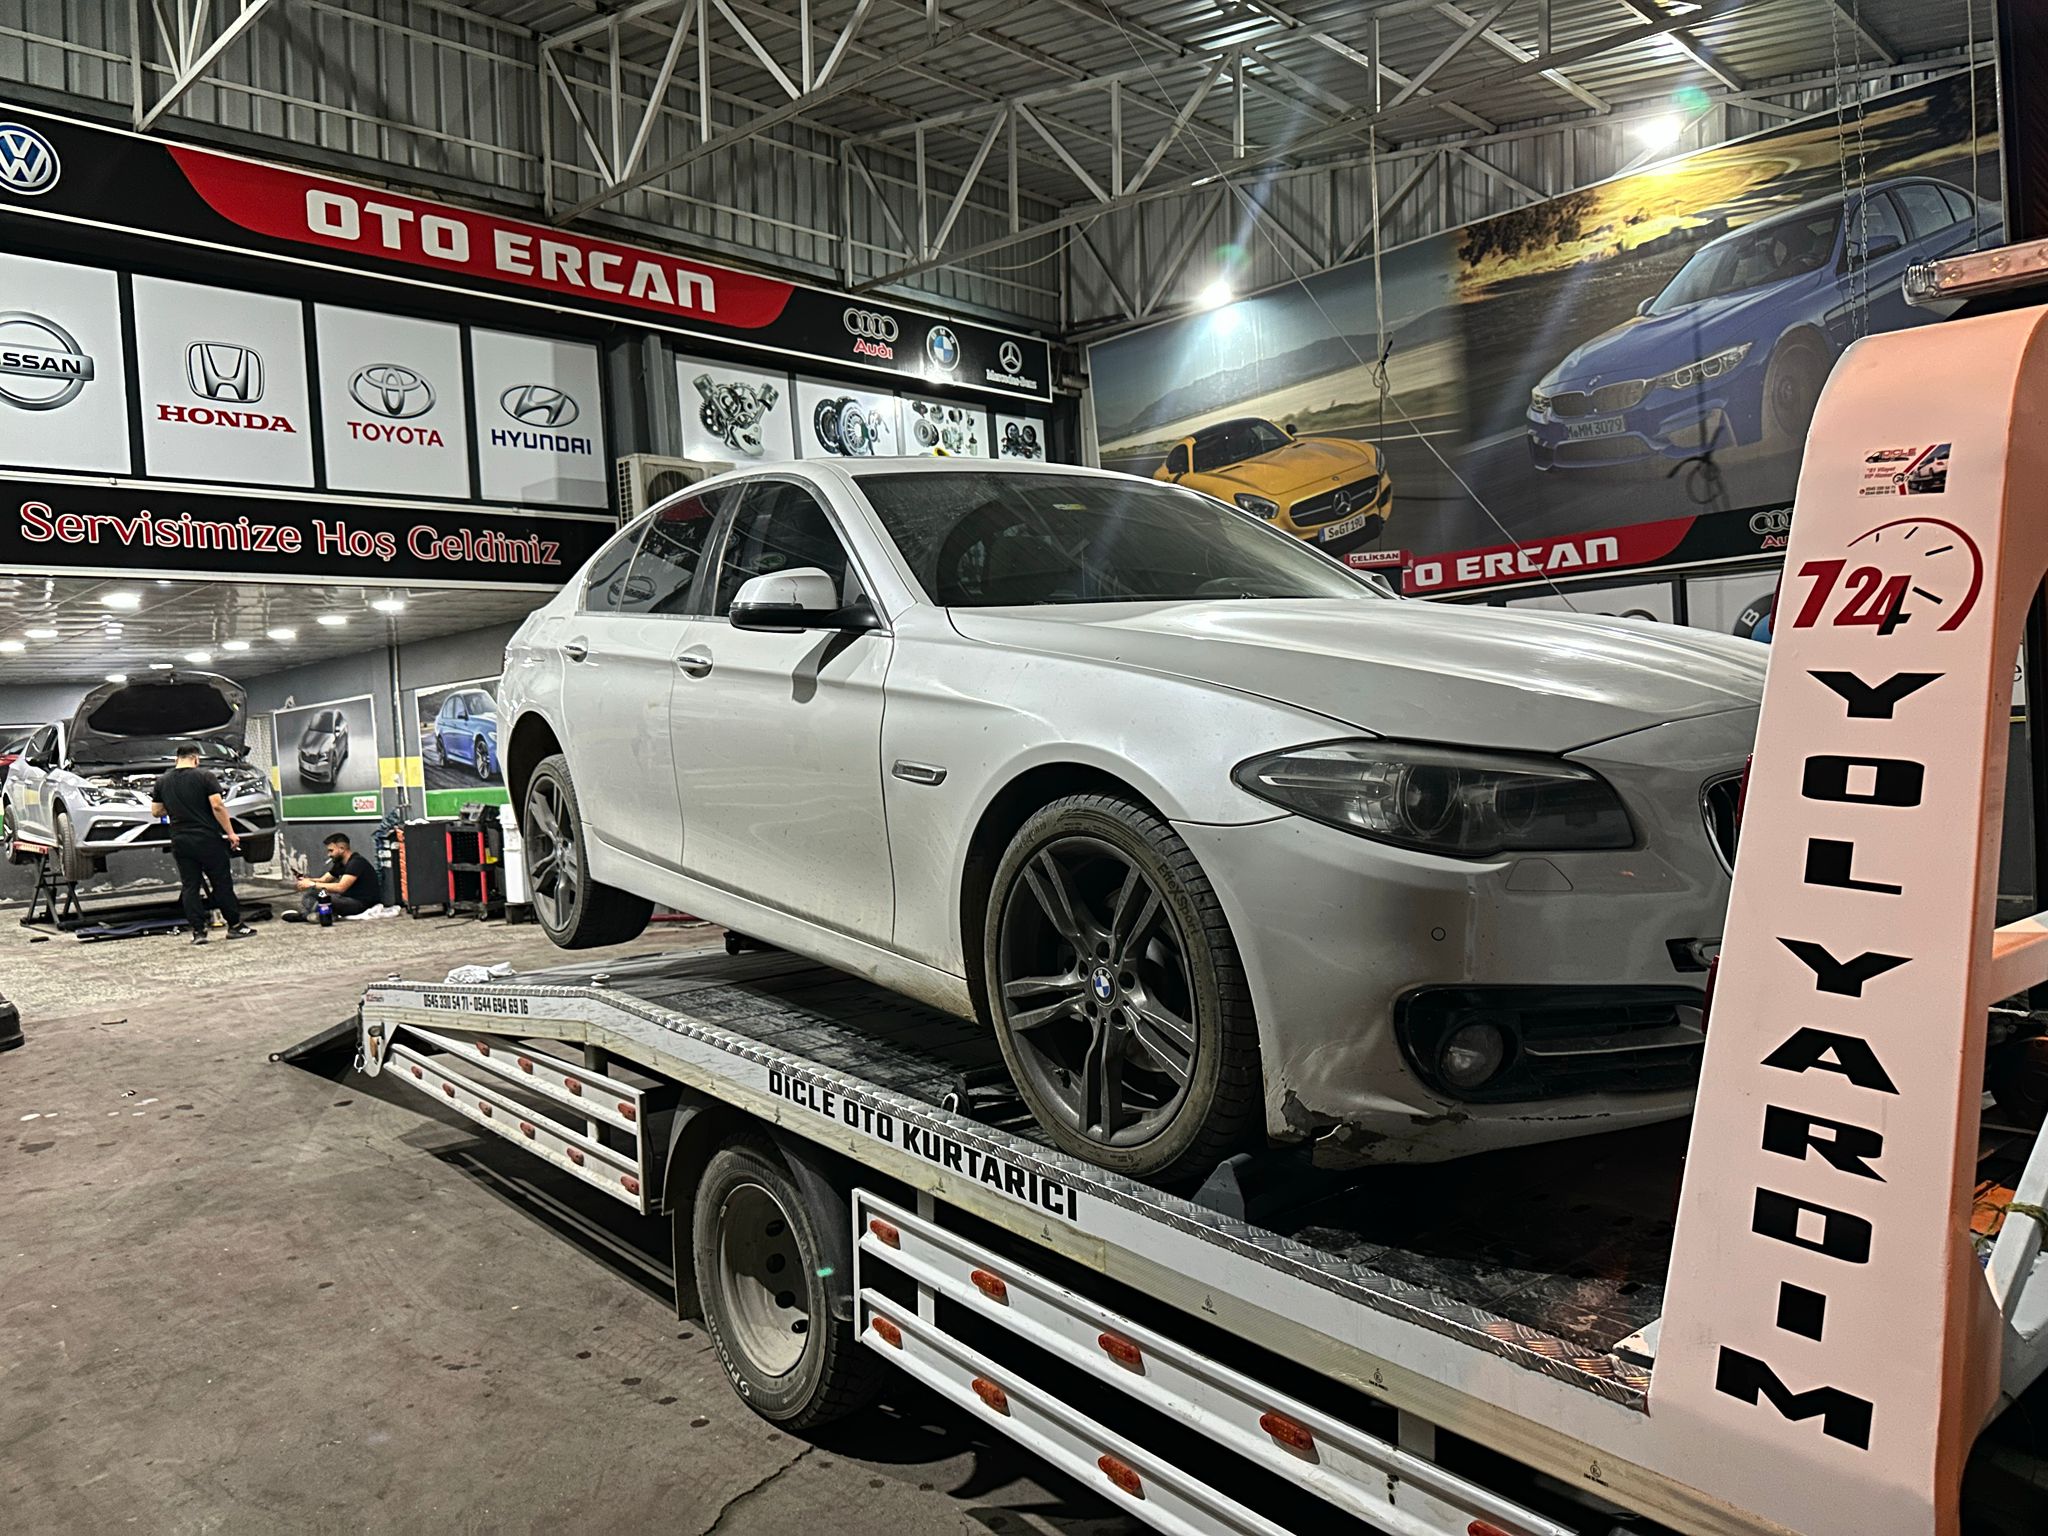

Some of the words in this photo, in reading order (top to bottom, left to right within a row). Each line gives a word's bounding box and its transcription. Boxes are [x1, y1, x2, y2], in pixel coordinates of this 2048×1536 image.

[305, 188, 470, 264] OTO
[493, 227, 717, 314] ERCAN
[853, 338, 893, 360] Audi
[0, 351, 82, 375] SSAN
[156, 404, 297, 433] HONDA
[346, 421, 445, 448] TOYOTA
[490, 428, 592, 455] HYUNDAI
[20, 500, 302, 553] Servisimize
[312, 518, 397, 562] Hoş
[407, 524, 562, 565] Geldiniz
[1760, 535, 1788, 549] Au
[1351, 552, 1400, 564] ÇELİKSAN
[1456, 536, 1619, 582] ERCAN
[423, 993, 439, 1009] 0545
[452, 995, 461, 1010] 54
[461, 996, 469, 1010] 71
[473, 996, 492, 1012] 0544
[492, 997, 507, 1013] 694
[508, 998, 519, 1014] 69
[519, 998, 529, 1015] 16
[843, 1098, 894, 1143] OTO
[902, 1121, 1079, 1222] KURTARICI
